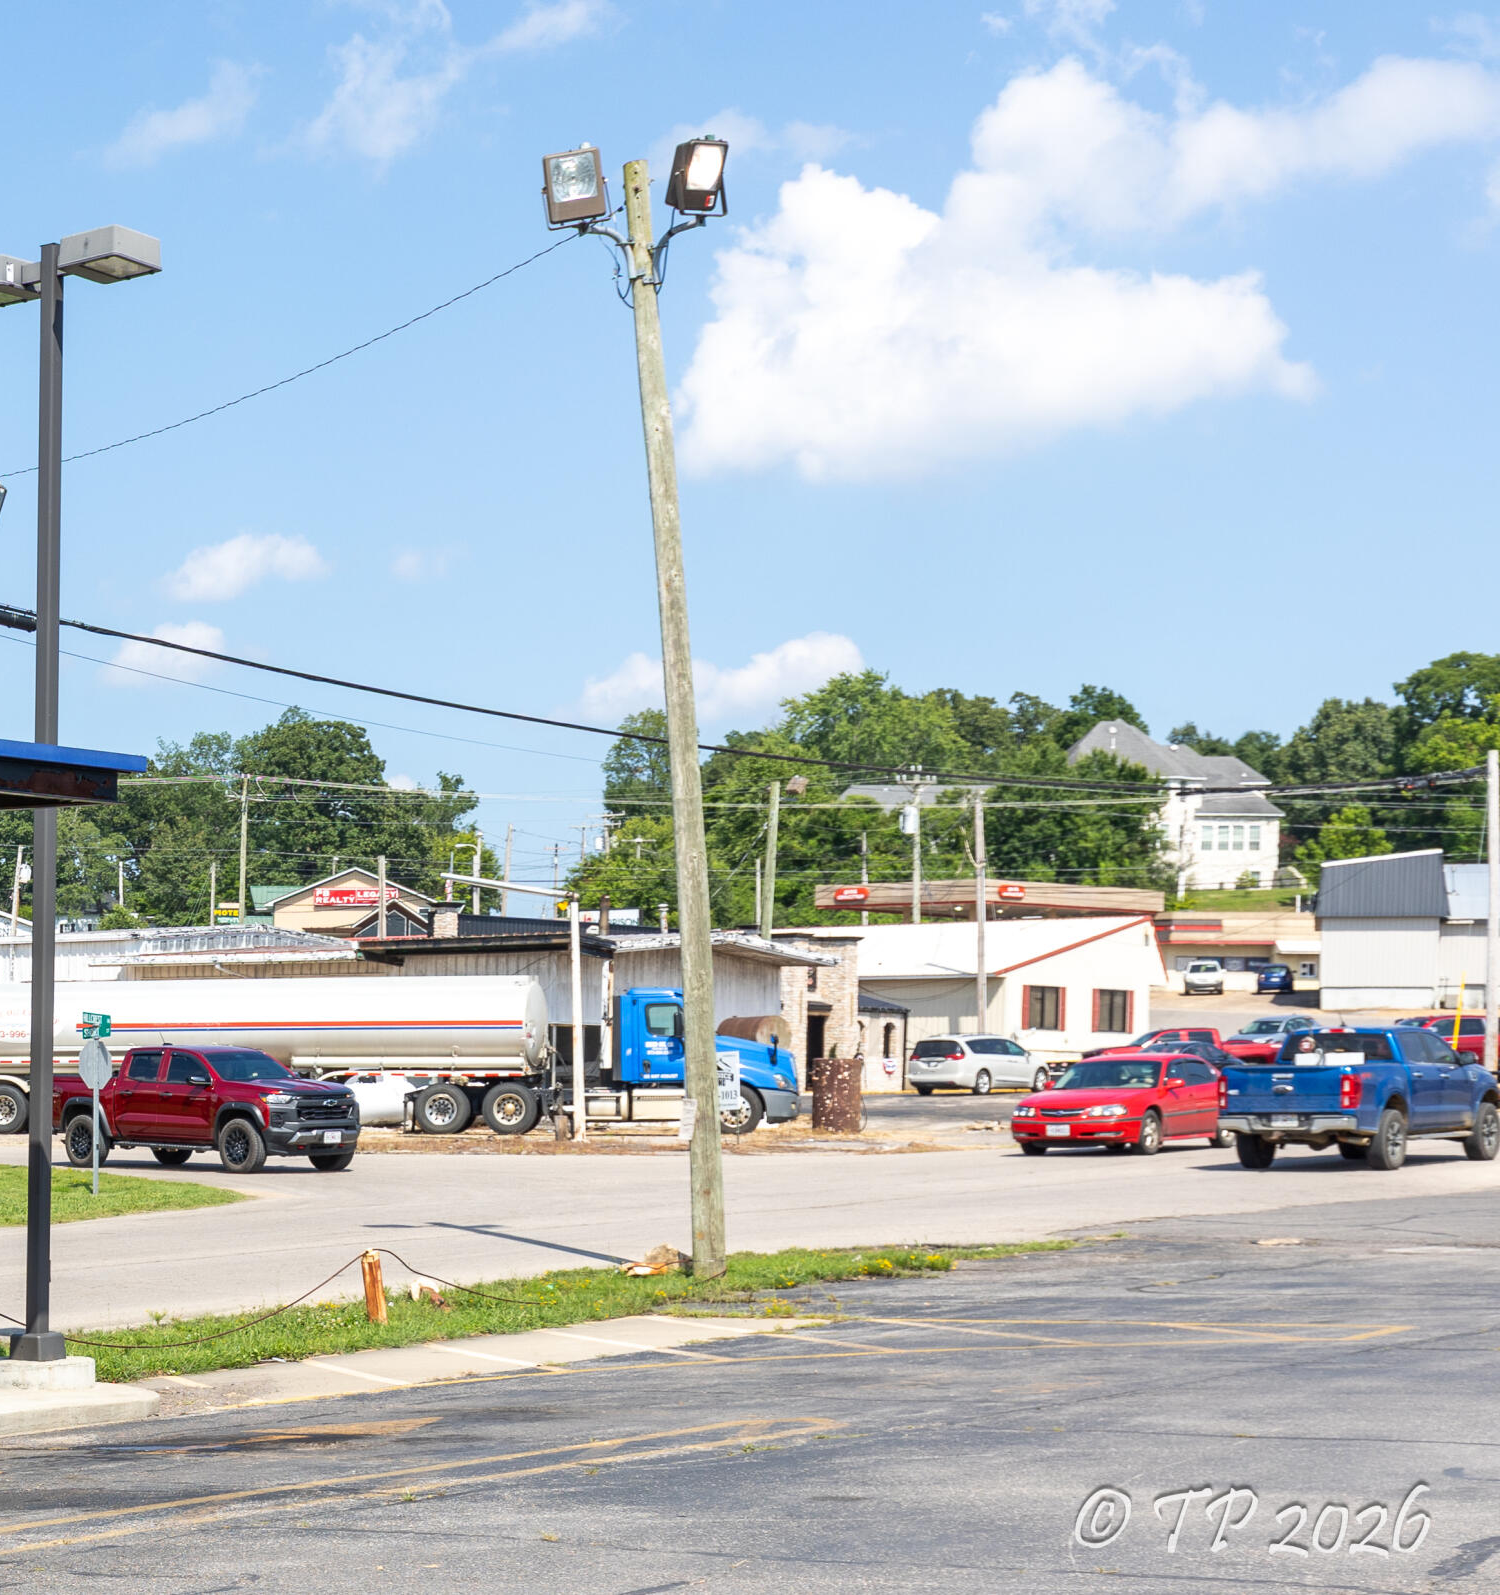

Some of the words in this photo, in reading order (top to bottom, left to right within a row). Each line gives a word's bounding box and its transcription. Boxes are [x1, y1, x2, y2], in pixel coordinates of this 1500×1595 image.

[315, 896, 355, 904] REALTY
[213, 909, 239, 917] MOTE
[718, 1090, 739, 1100] -1013
